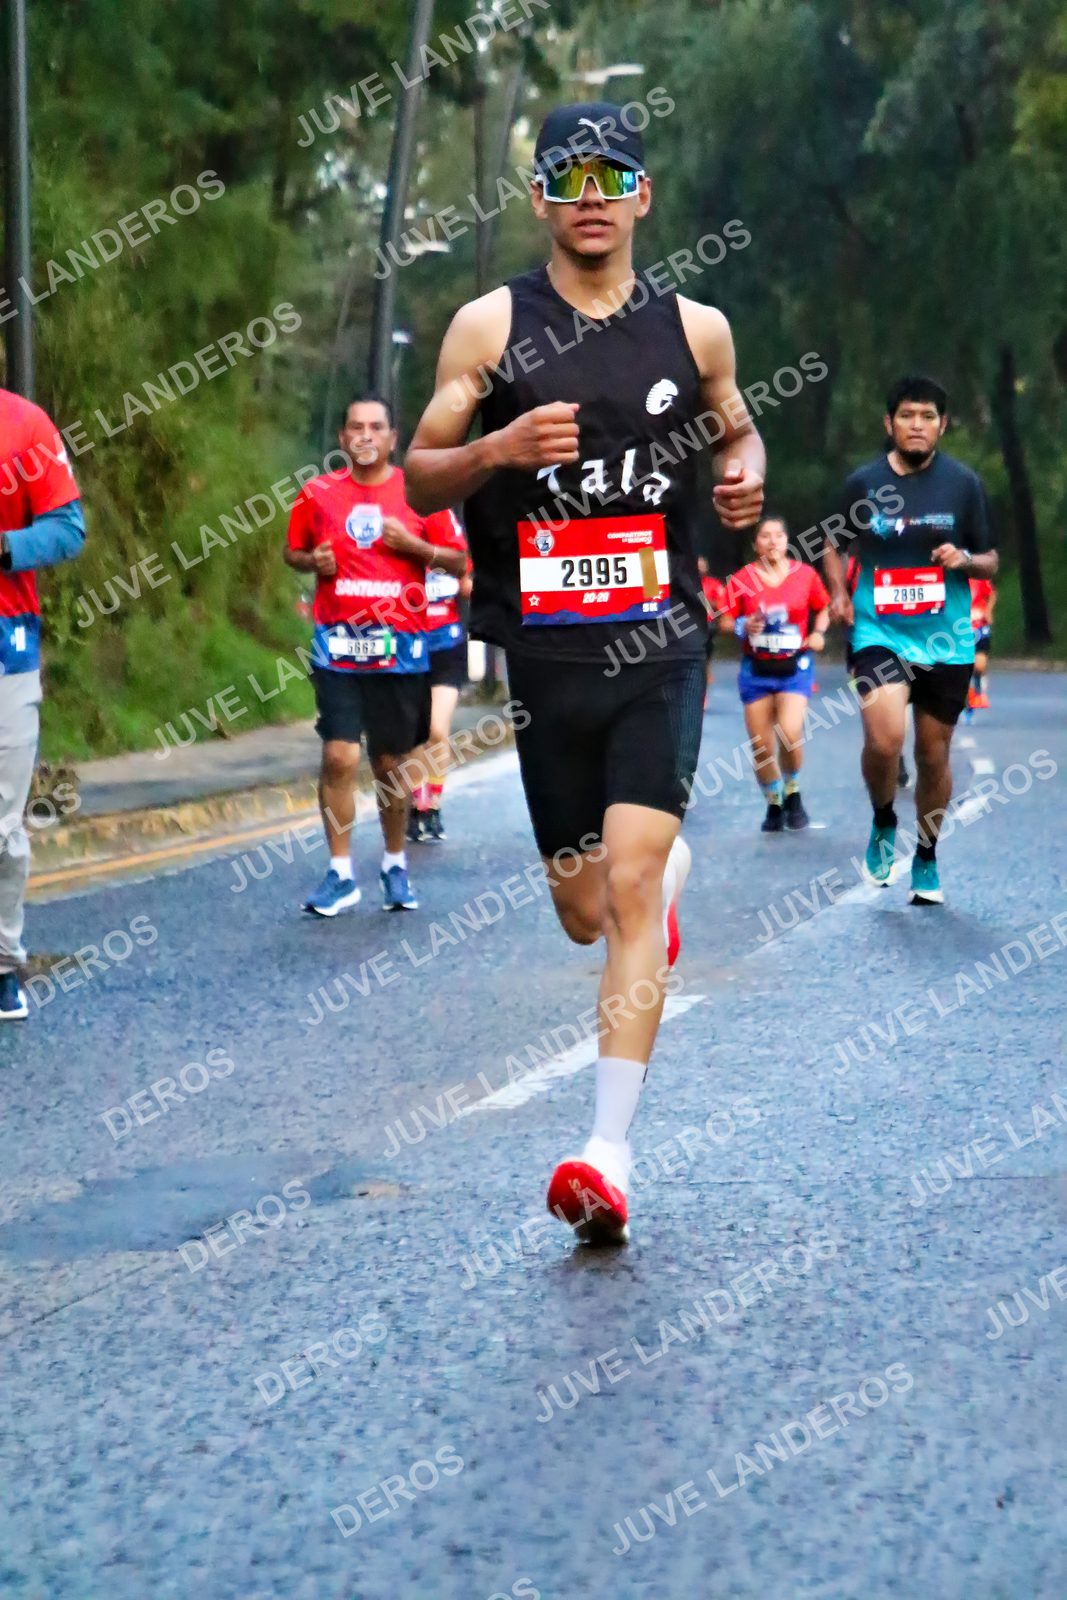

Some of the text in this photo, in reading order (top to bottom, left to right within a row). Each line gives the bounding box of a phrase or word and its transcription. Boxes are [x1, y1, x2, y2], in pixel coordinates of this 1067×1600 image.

[561, 557, 627, 588] 2995
[335, 578, 401, 598] SANTIAGO
[894, 587, 924, 602] 2896
[348, 640, 376, 655] 5662
